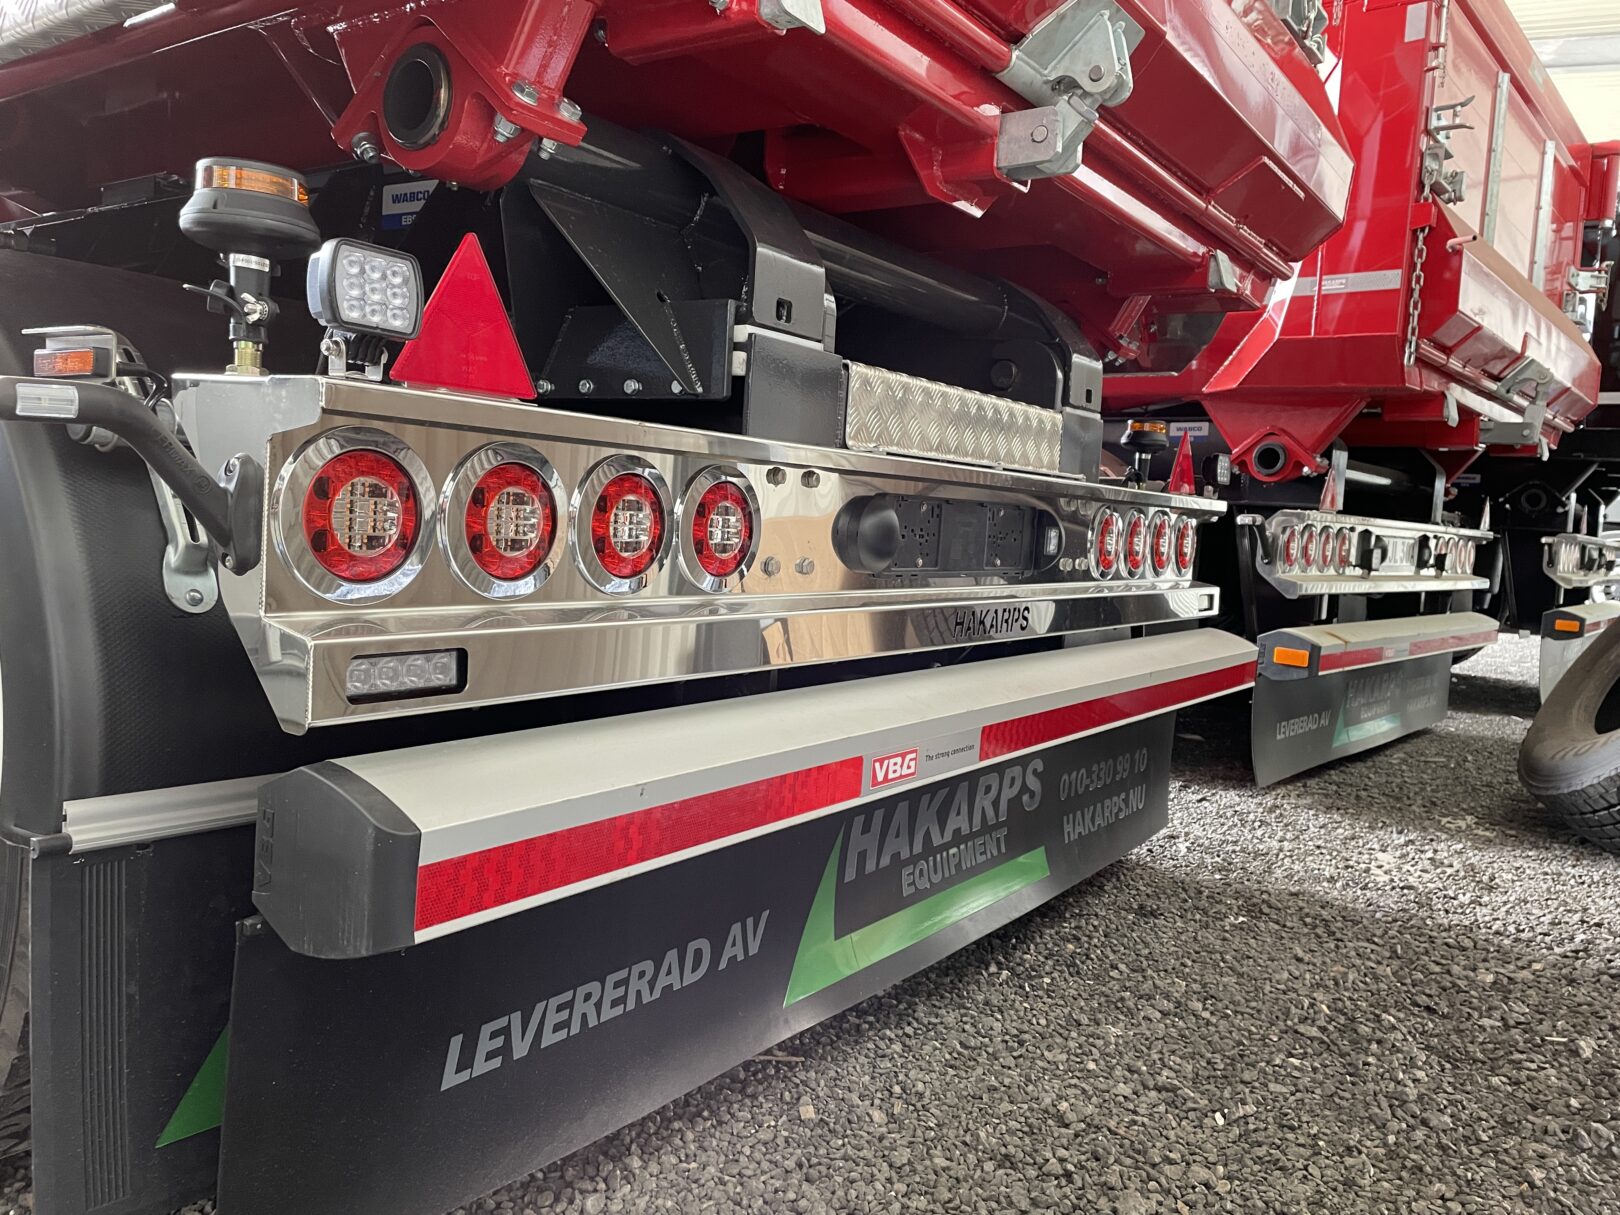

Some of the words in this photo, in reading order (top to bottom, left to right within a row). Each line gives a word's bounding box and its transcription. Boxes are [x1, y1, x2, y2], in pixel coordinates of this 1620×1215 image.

[391, 190, 430, 204] WABCO
[952, 605, 1030, 639] HAKARPS
[1276, 711, 1320, 741] LEVERERAD
[1319, 709, 1332, 728] AV
[874, 753, 917, 782] VBG
[925, 754, 934, 762] The
[934, 750, 950, 760] strong
[950, 744, 975, 756] connection
[1060, 758, 1114, 801] 010-330
[1115, 753, 1131, 781] 99
[1134, 747, 1148, 774] 10
[844, 758, 1044, 884] HAKARPS
[1063, 783, 1146, 844] HAKARPS.NU
[901, 826, 1008, 897] EQUIPMENT
[440, 937, 711, 1092] LEVERERAD
[717, 909, 770, 971] AV
